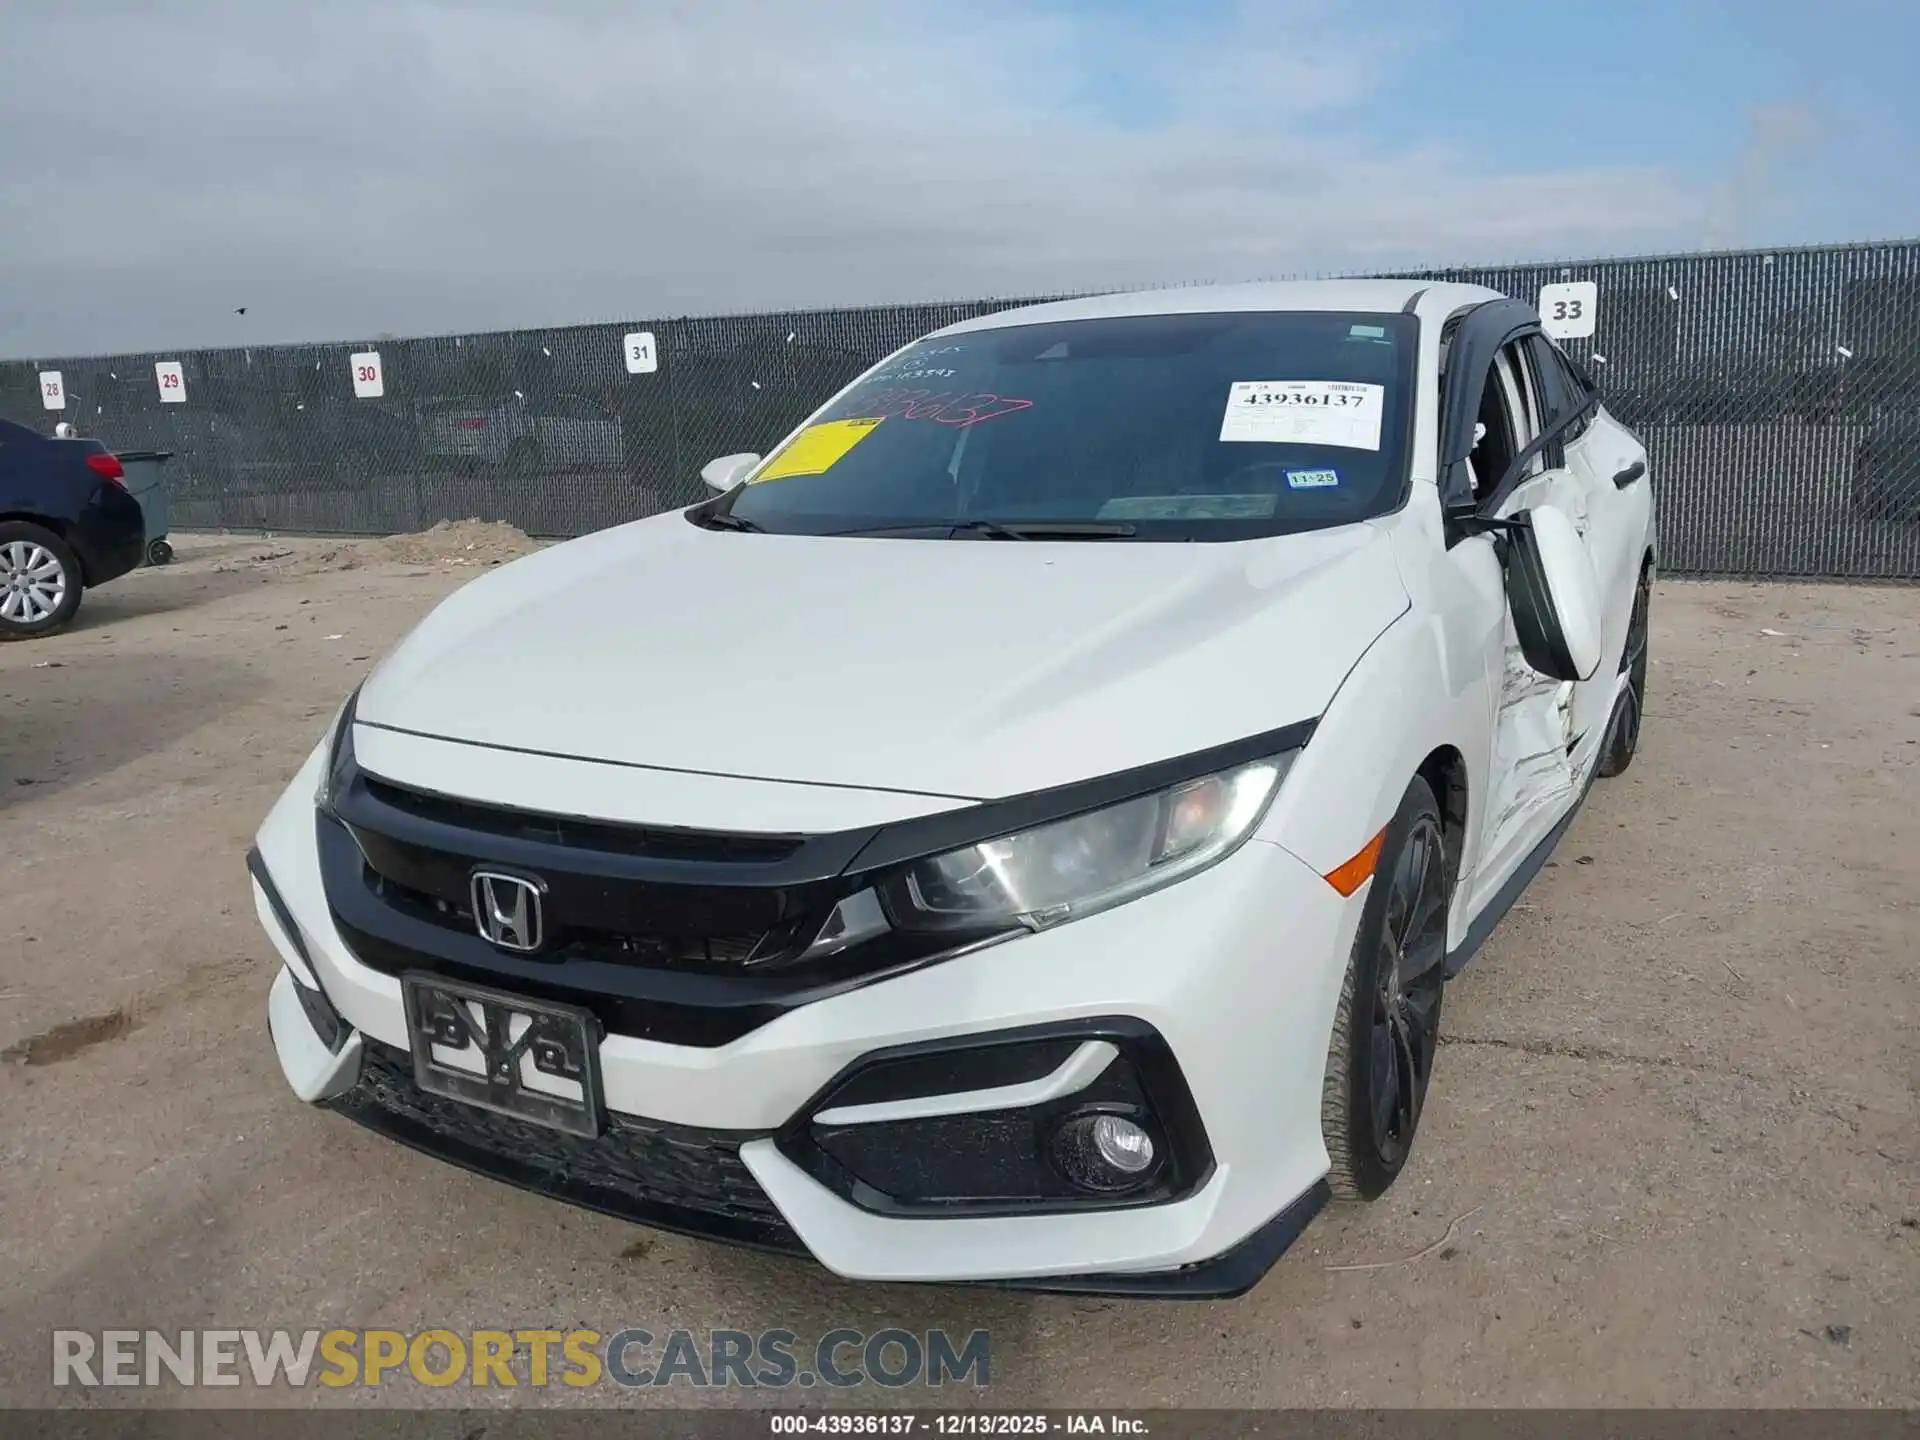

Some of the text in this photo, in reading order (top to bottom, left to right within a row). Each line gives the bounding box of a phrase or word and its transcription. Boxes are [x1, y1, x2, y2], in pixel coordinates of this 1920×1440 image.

[1553, 300, 1582, 320] 33
[632, 345, 648, 360] 31
[358, 366, 376, 381] 30
[163, 374, 178, 388] 29
[45, 383, 59, 396] 28
[1243, 393, 1364, 407] 43936137
